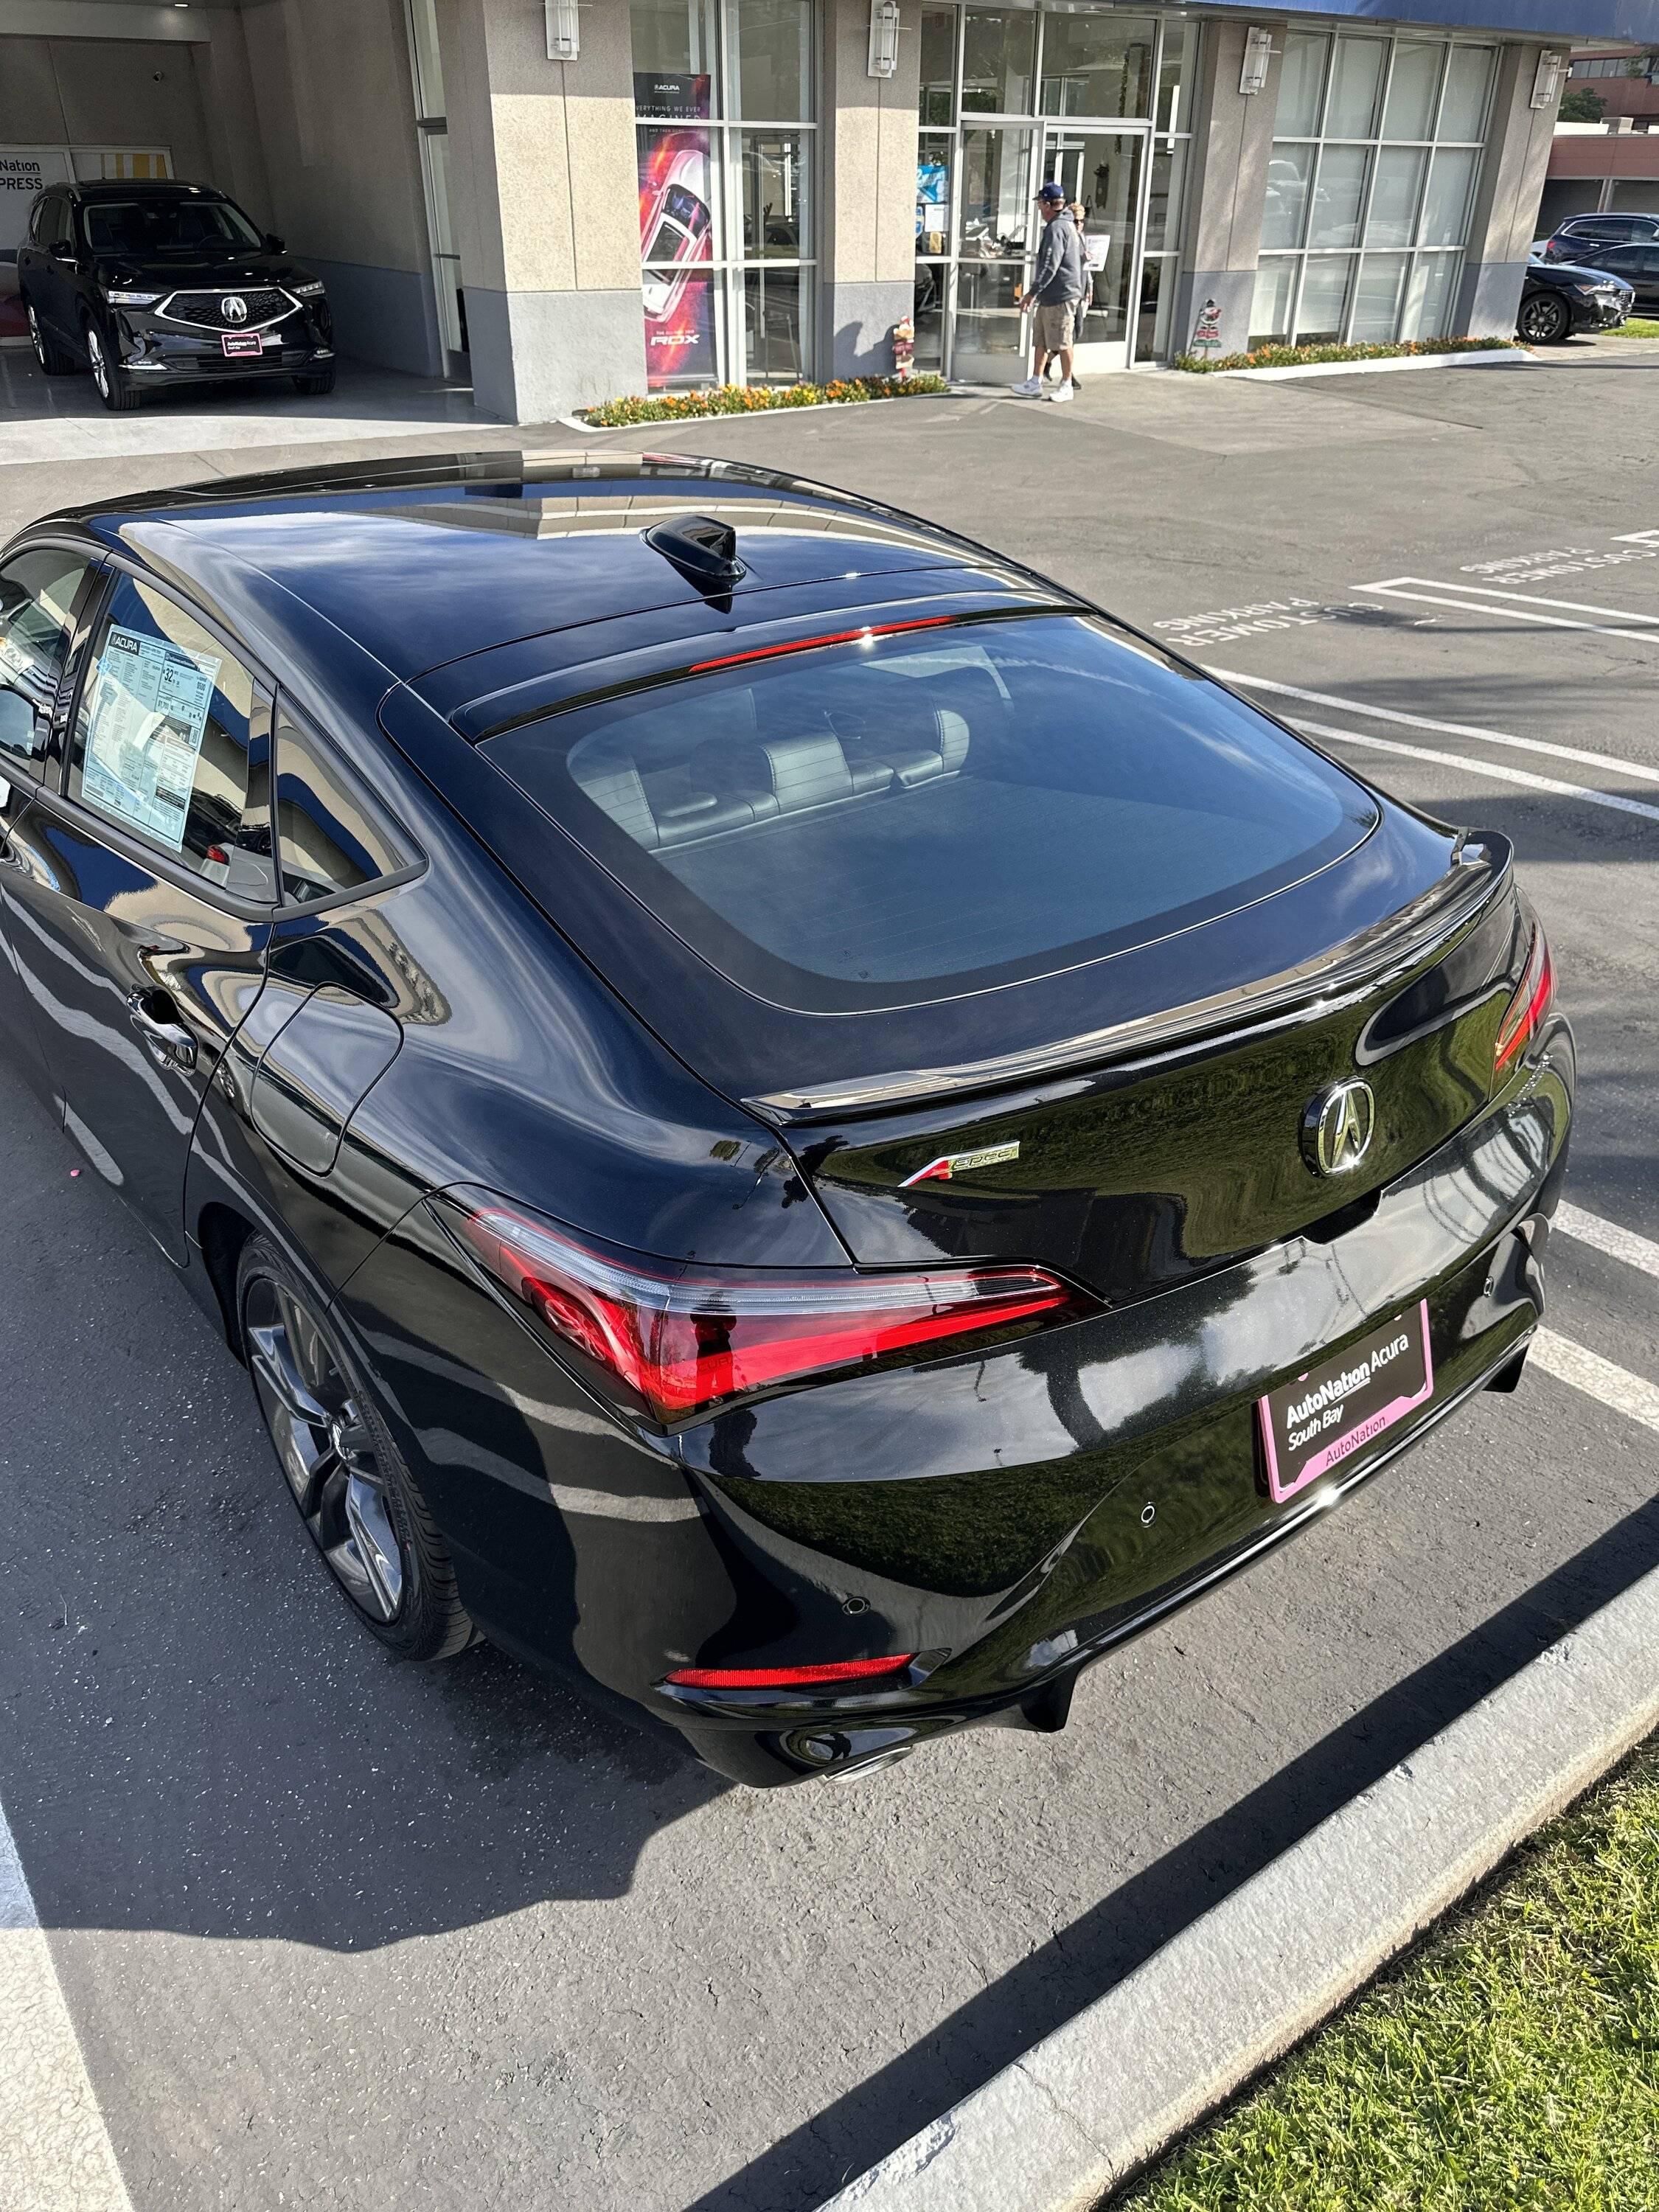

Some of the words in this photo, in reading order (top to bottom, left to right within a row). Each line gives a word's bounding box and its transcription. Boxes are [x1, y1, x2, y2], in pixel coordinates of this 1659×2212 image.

[650, 334, 700, 346] RDX
[1460, 546, 1595, 574] PARKING
[1481, 549, 1657, 584] CUSTOMER
[1152, 597, 1320, 631] PARKING
[1166, 601, 1384, 647] CUSTOMER
[115, 636, 138, 653] ACURA
[164, 668, 173, 682] 32
[1287, 1362, 1371, 1429] AutoNation
[1371, 1333, 1409, 1372] Acura
[1288, 1419, 1321, 1451] South
[1322, 1404, 1344, 1429] Bay
[1325, 1416, 1386, 1467] AutoNation
